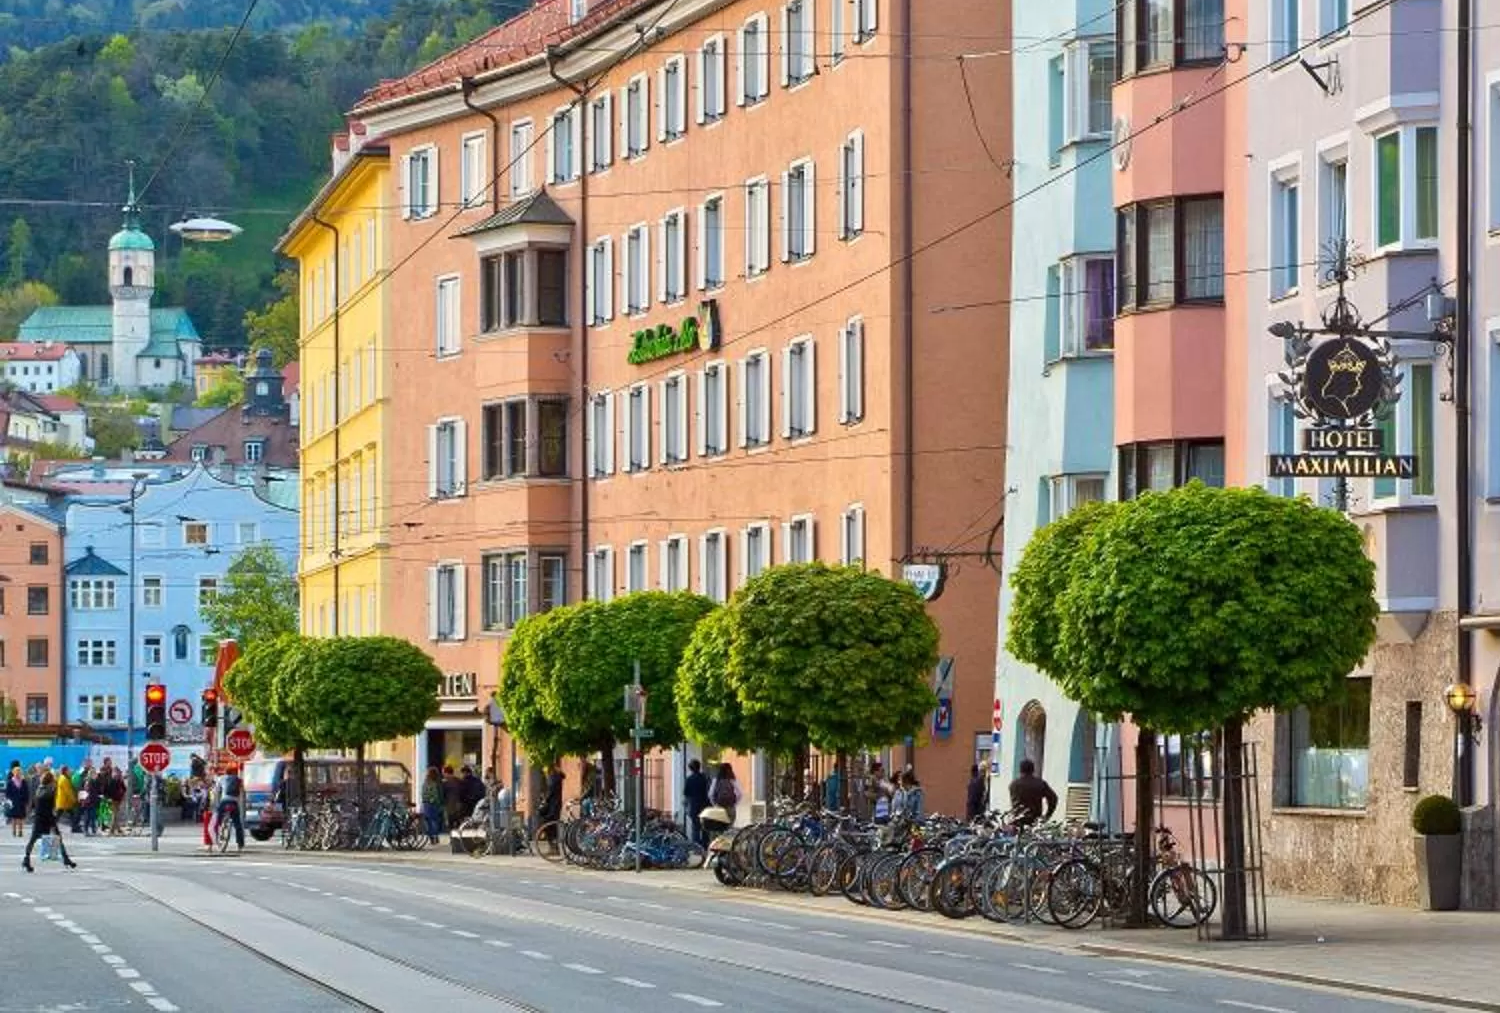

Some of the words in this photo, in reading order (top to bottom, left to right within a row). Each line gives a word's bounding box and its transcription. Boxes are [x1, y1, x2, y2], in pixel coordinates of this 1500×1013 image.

[1310, 430, 1381, 448] HOTEL
[1275, 457, 1414, 475] MAXIMILIAN
[142, 752, 168, 764] STOP
